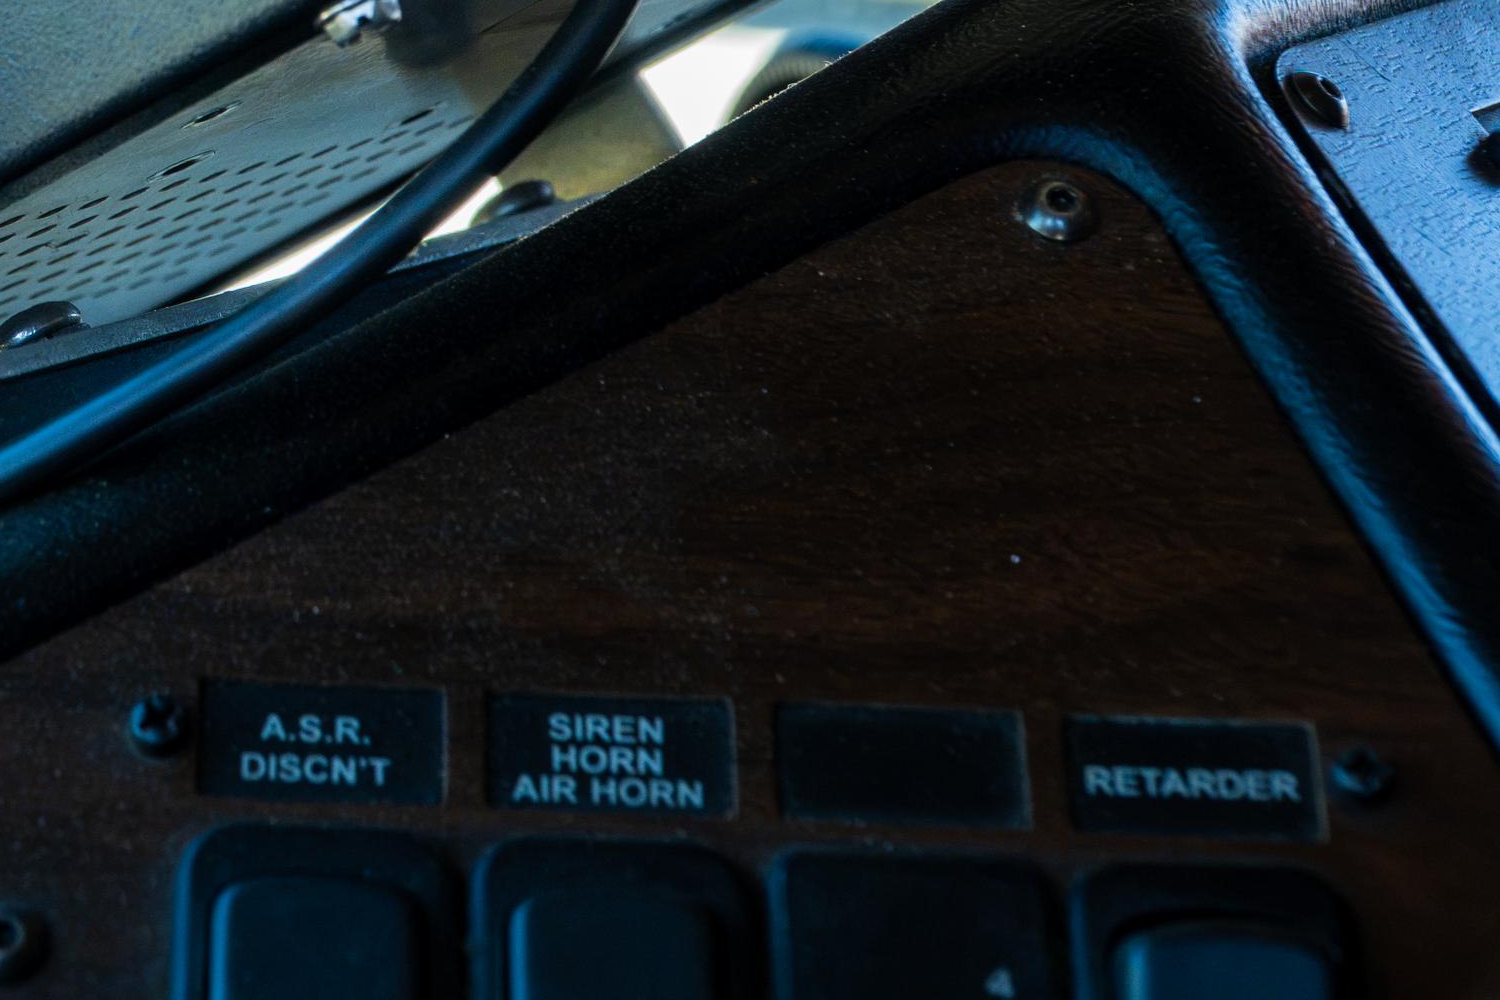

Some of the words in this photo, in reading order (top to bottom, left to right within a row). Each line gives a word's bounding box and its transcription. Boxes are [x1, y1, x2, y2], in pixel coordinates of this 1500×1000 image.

[260, 712, 371, 746] A.S.R.
[548, 711, 665, 745] SIREN
[240, 751, 392, 786] DISCN'T
[551, 744, 664, 777] HORN
[512, 773, 578, 804] AIR
[591, 776, 704, 809] HORN
[1083, 764, 1300, 804] RETARDER
